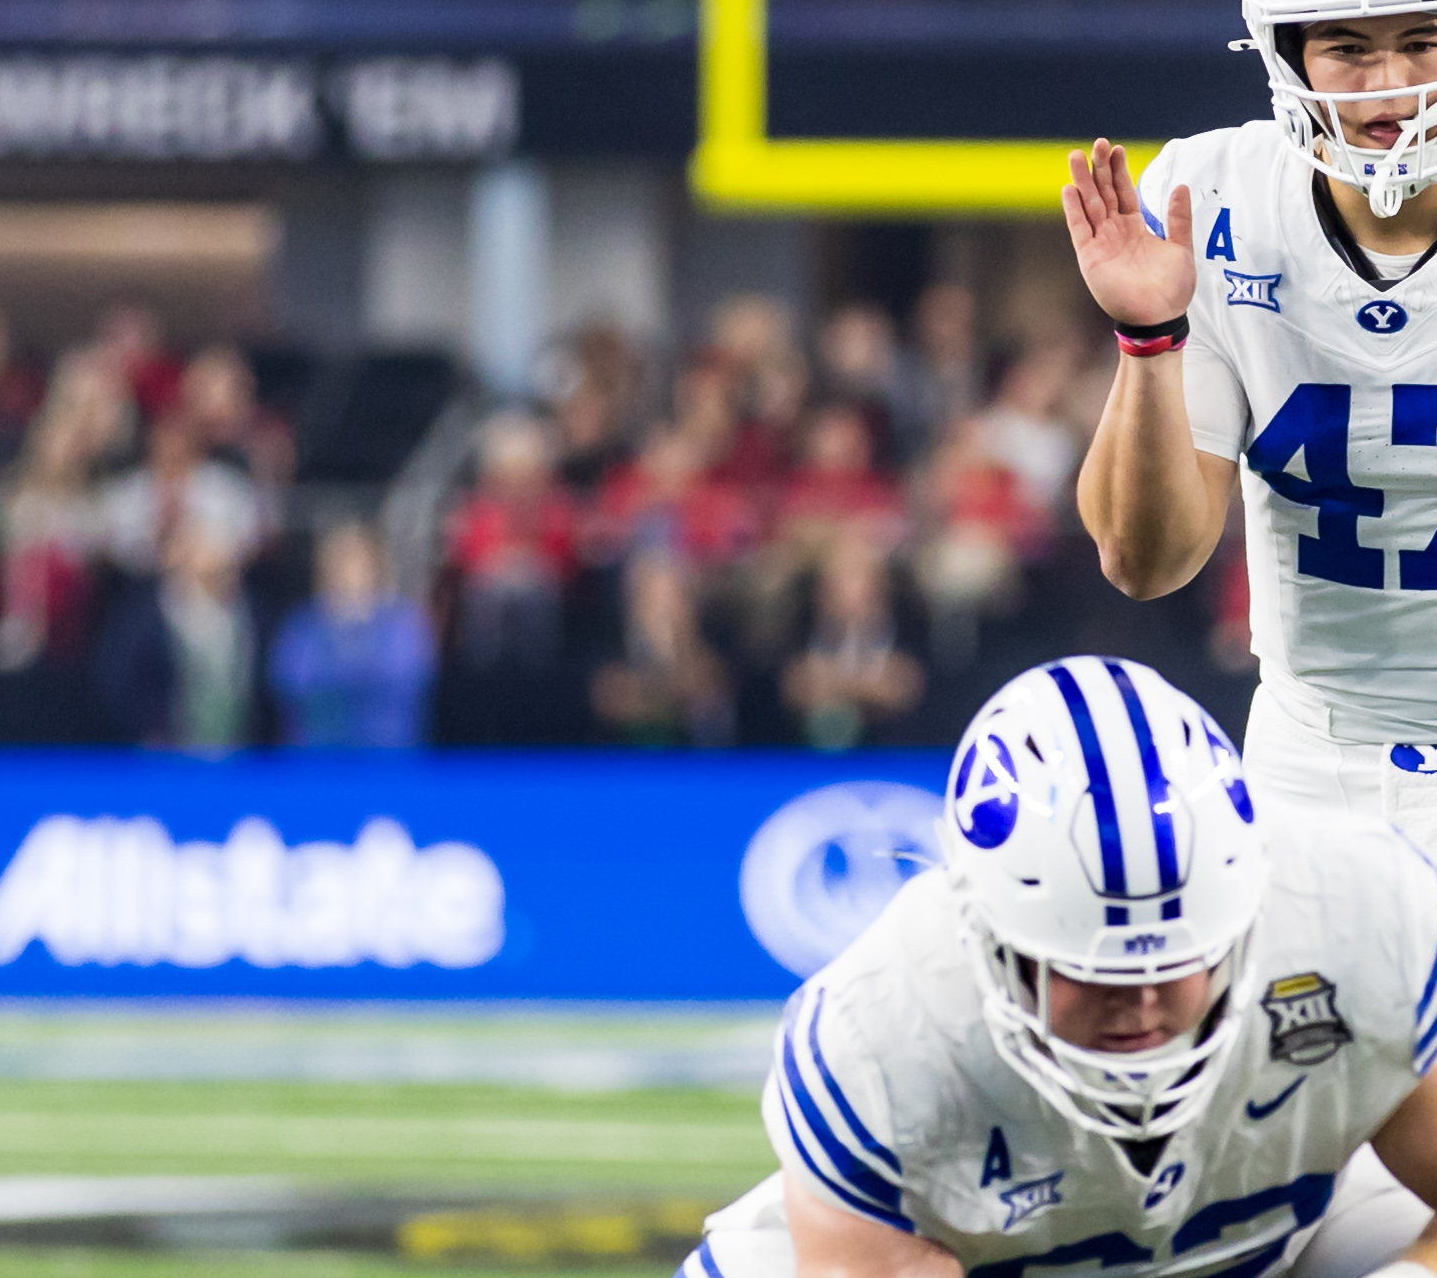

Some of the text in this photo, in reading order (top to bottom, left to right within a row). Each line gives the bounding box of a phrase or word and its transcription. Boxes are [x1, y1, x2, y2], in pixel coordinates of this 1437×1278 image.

[1205, 207, 1237, 261] A
[1225, 272, 1277, 309] XII
[1364, 305, 1398, 328] Y
[980, 1125, 1011, 1189] A
